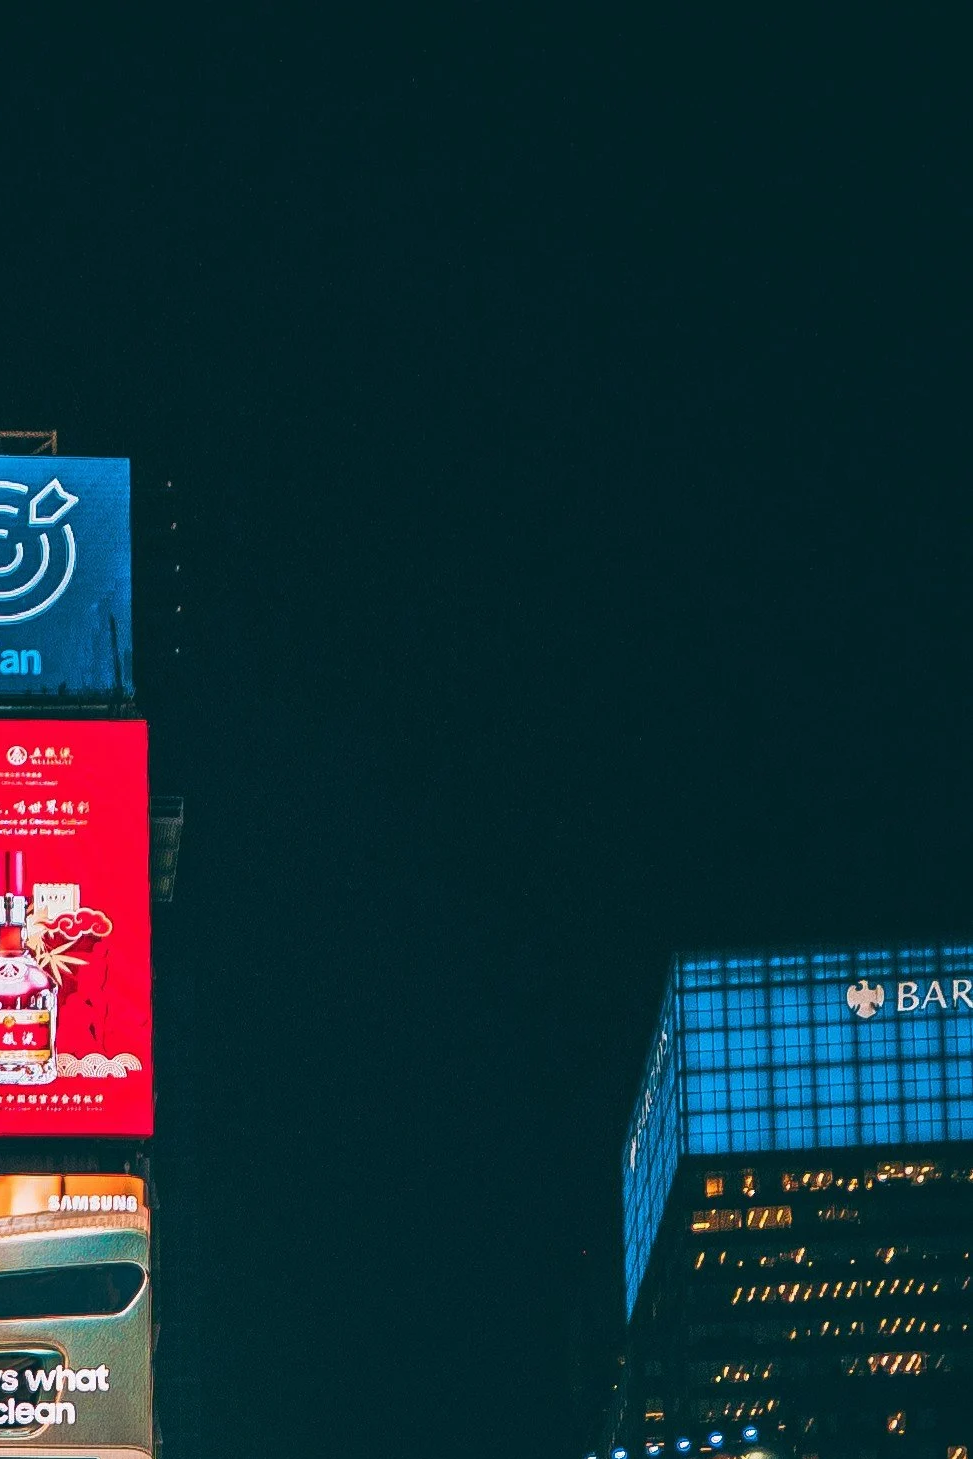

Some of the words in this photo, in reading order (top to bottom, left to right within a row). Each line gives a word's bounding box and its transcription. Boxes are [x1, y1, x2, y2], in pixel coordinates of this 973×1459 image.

[897, 979, 973, 1012] BAR
[48, 1195, 139, 1213] SAMSUNG
[24, 1363, 110, 1393] what
